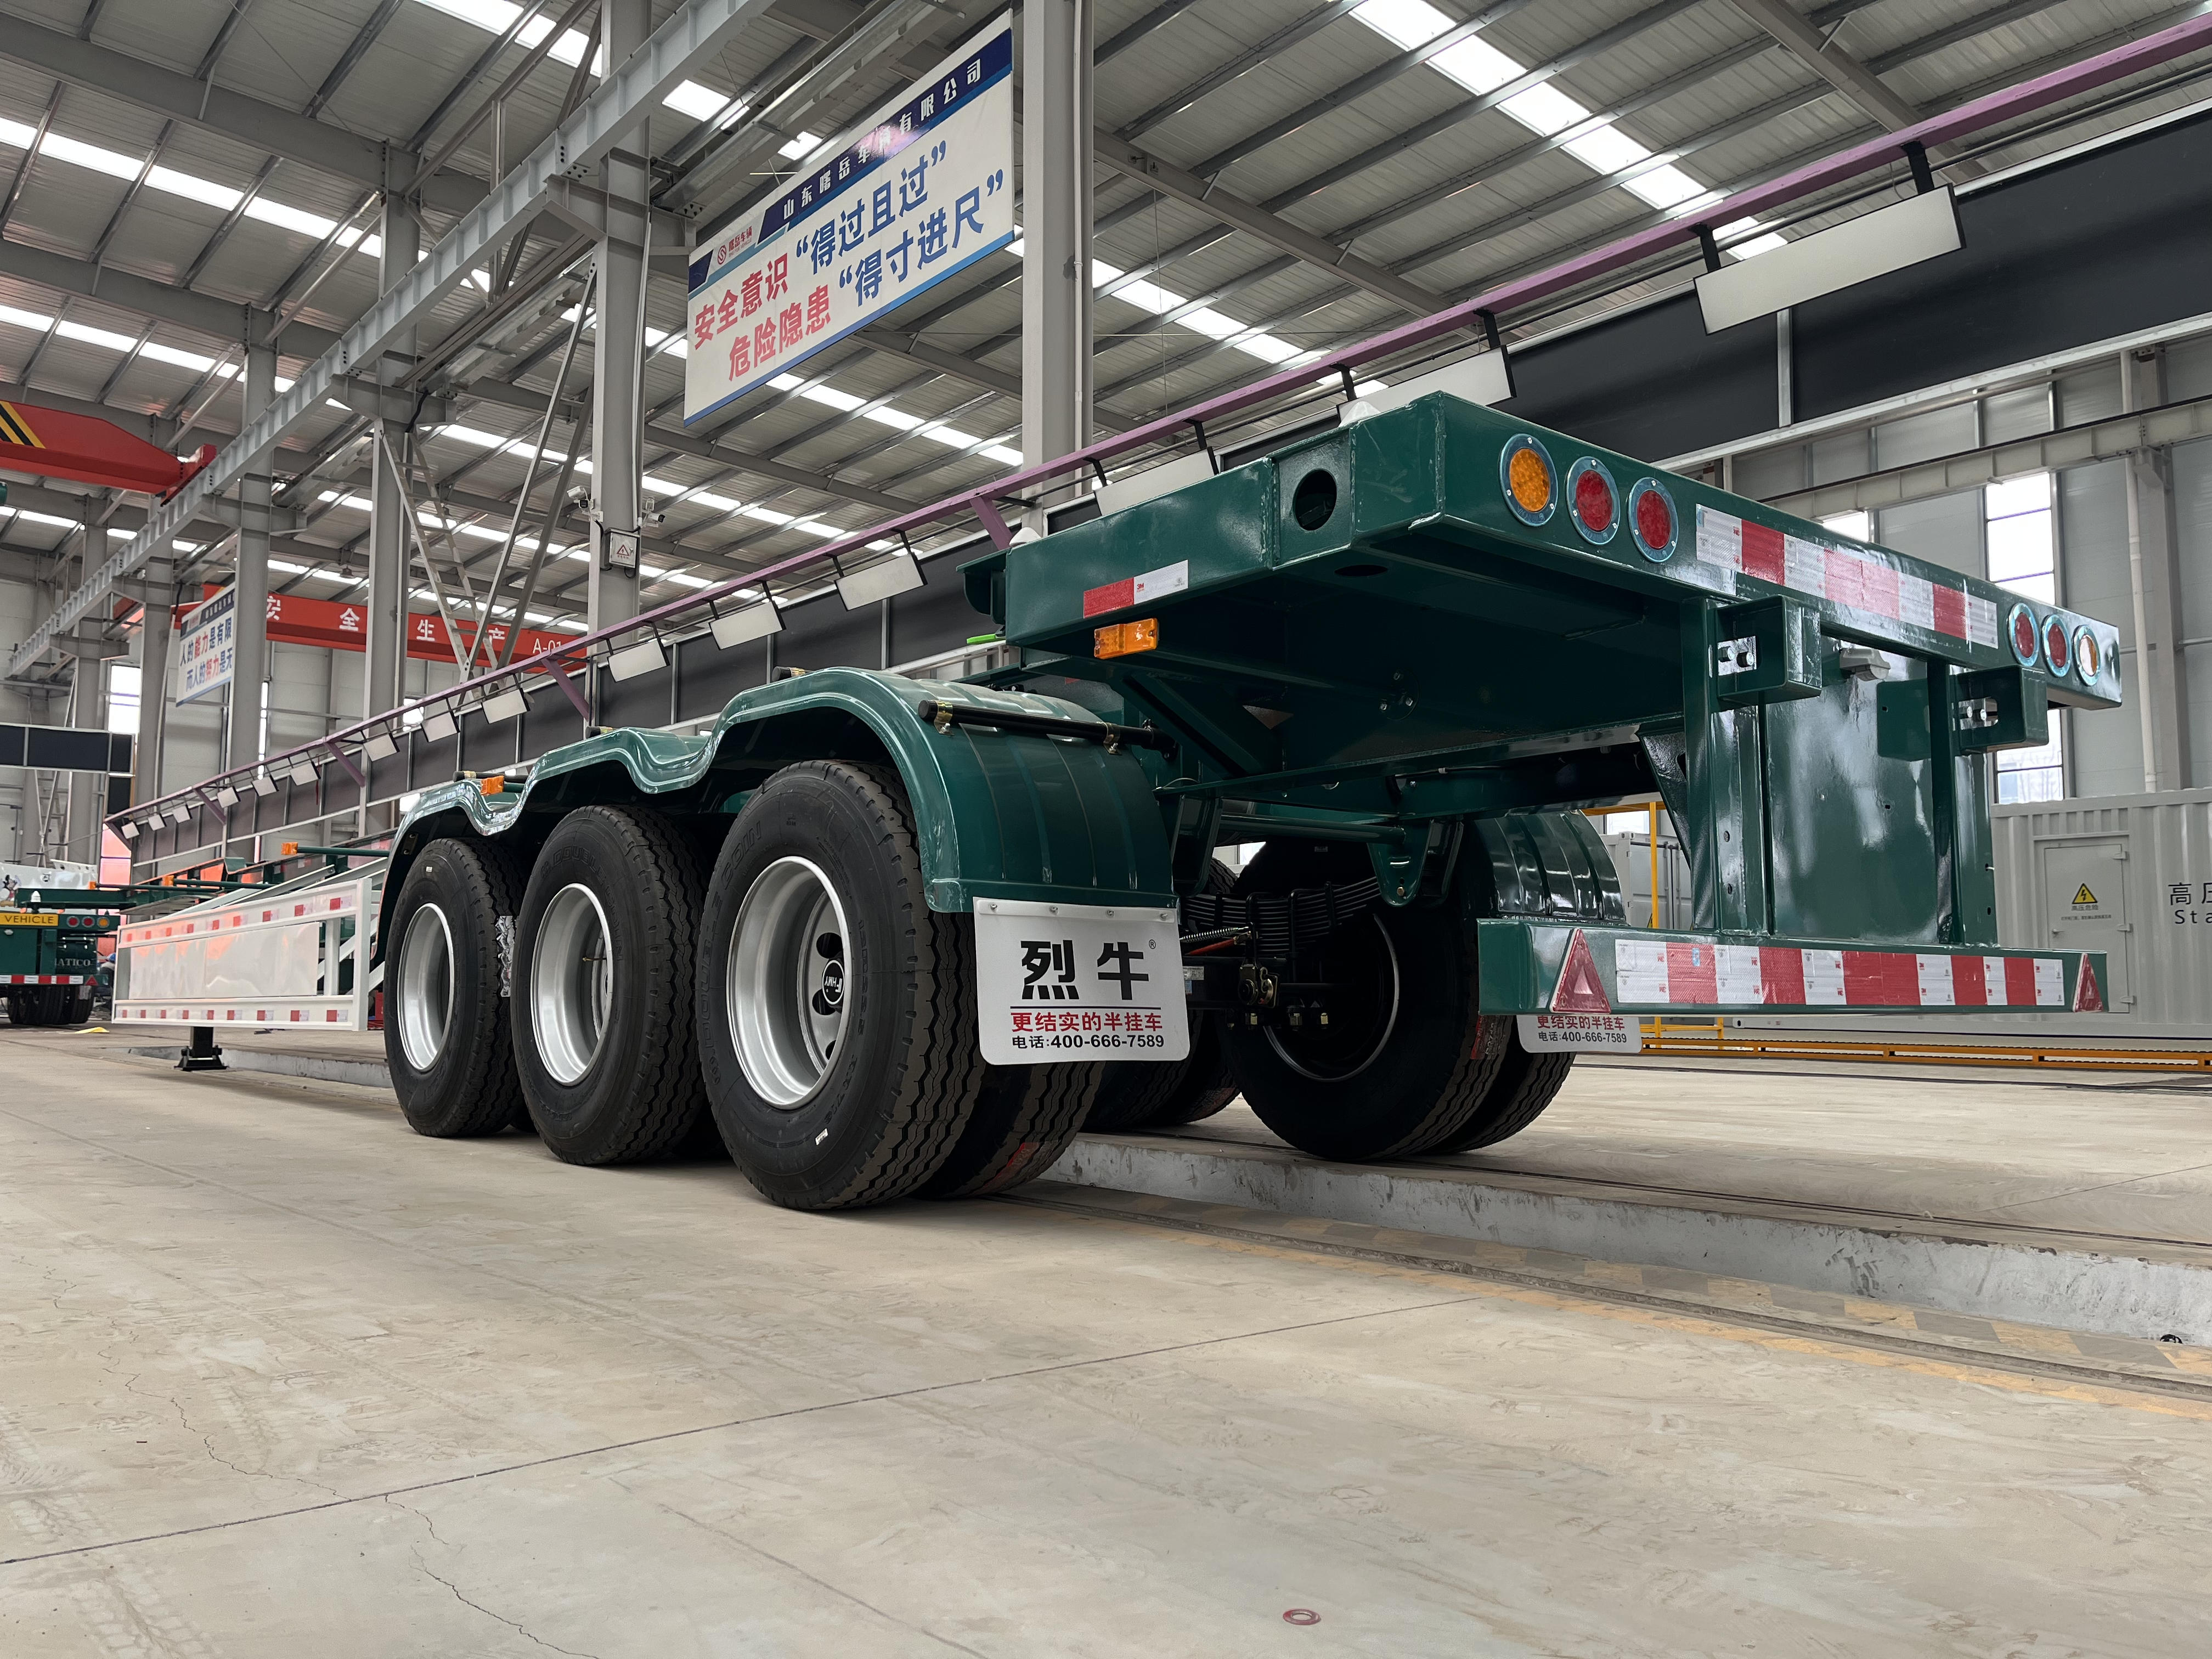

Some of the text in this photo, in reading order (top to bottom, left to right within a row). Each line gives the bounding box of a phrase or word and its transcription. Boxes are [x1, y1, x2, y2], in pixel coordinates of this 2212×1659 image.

[694, 252, 788, 350] 安全意识
[729, 284, 832, 382] 危险隐患
[720, 820, 762, 890] COIN
[4, 915, 54, 924] VEHICLE
[1011, 1012, 1163, 1032] 更结实的半挂车
[1537, 1015, 1625, 1031] 更结实的半挂车
